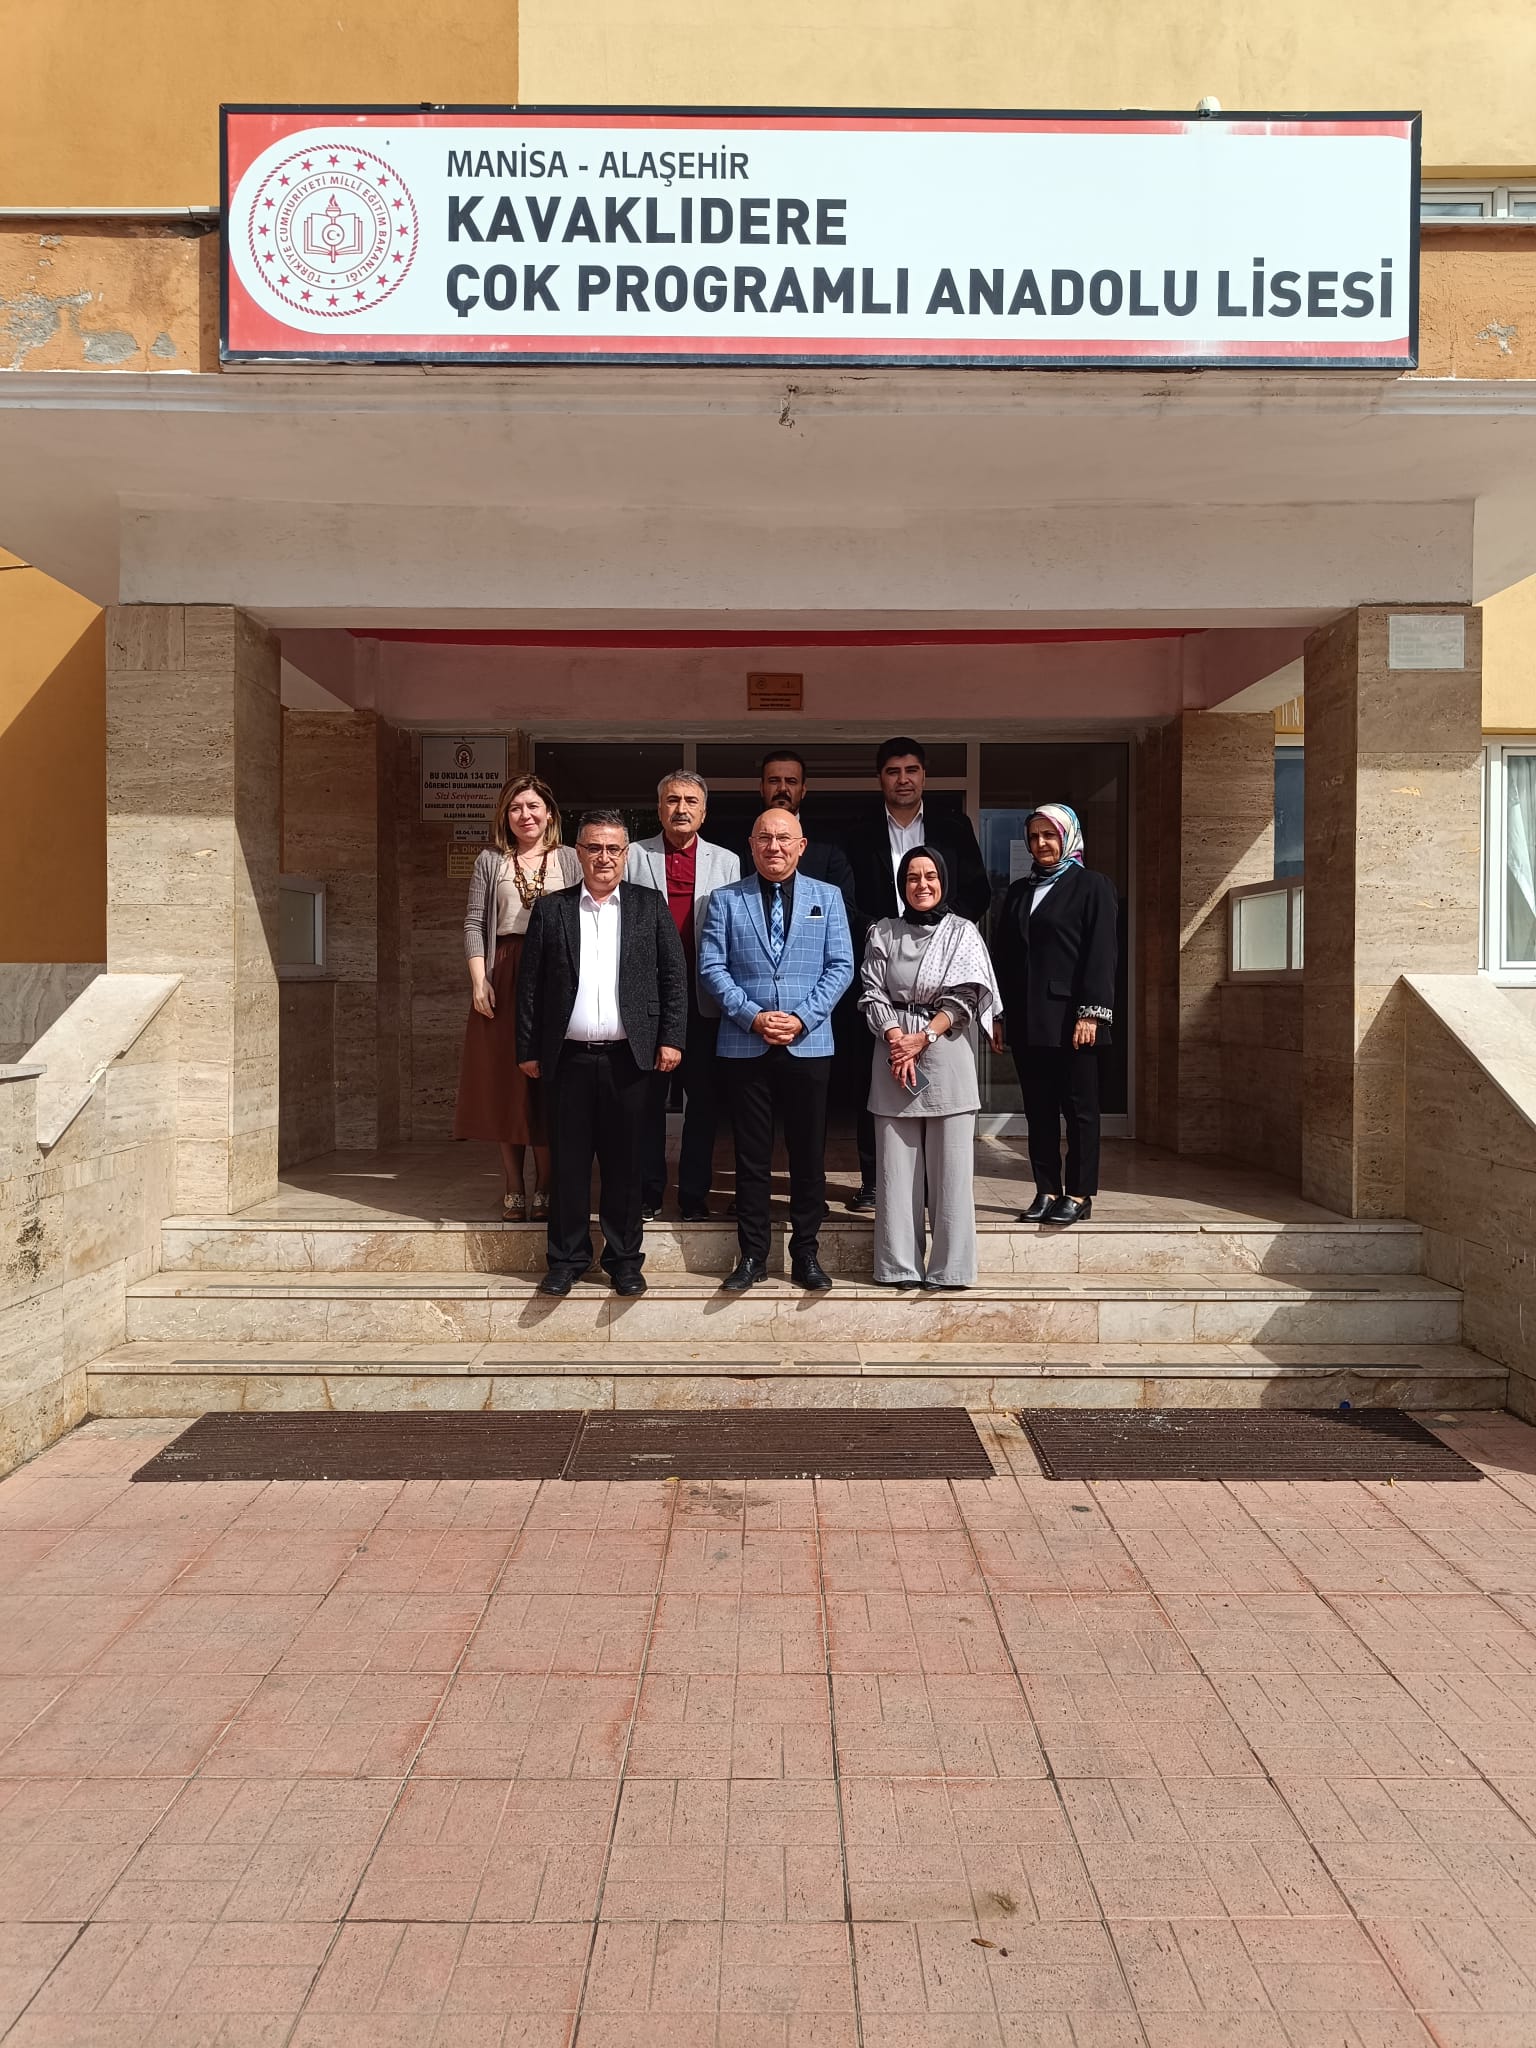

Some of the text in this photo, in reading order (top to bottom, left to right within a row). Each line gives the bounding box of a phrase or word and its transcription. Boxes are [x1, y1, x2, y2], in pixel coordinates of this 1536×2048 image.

[448, 143, 568, 178] MANİSA
[599, 145, 748, 187] ALAŞEHİR
[279, 175, 387, 283] TÜRKİYE CUMHURİYETİ MİLLİ EĞİTİM BAKANLIĞI
[448, 196, 847, 245] KAVAKLIDERE
[447, 258, 1392, 317] ÇOK PROGRAMLI ANADOLU LİSESİ
